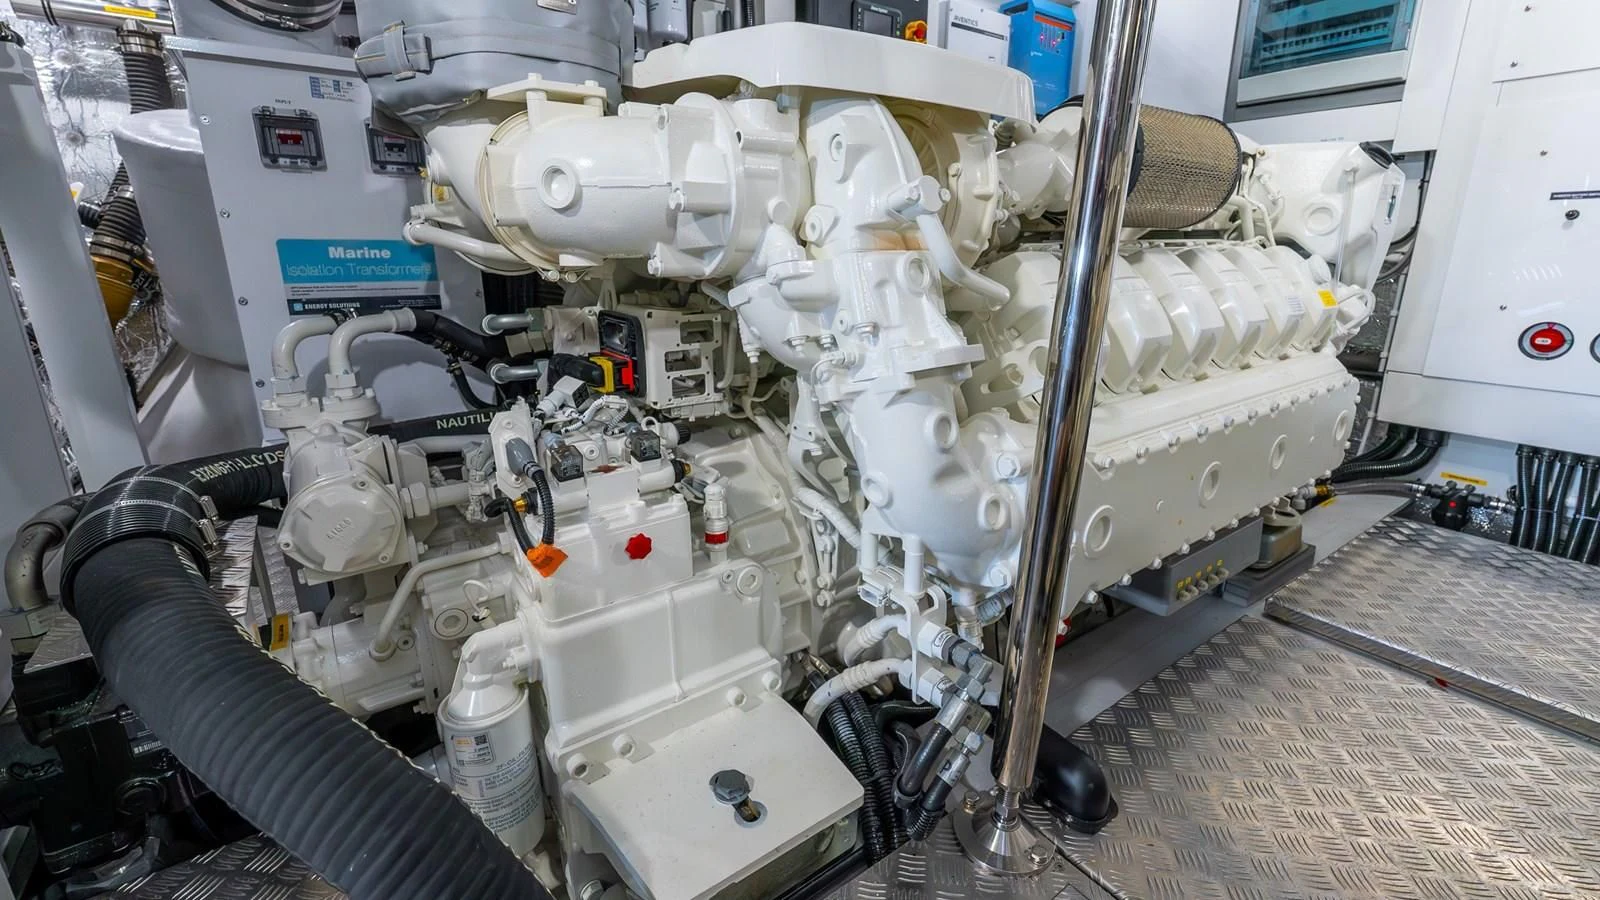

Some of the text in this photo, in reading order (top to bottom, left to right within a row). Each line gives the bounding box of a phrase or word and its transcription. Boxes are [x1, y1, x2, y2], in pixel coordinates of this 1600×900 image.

[953, 15, 978, 27] AVENTICS
[328, 246, 391, 259] Marine
[286, 262, 432, 277] Isolation Transformers
